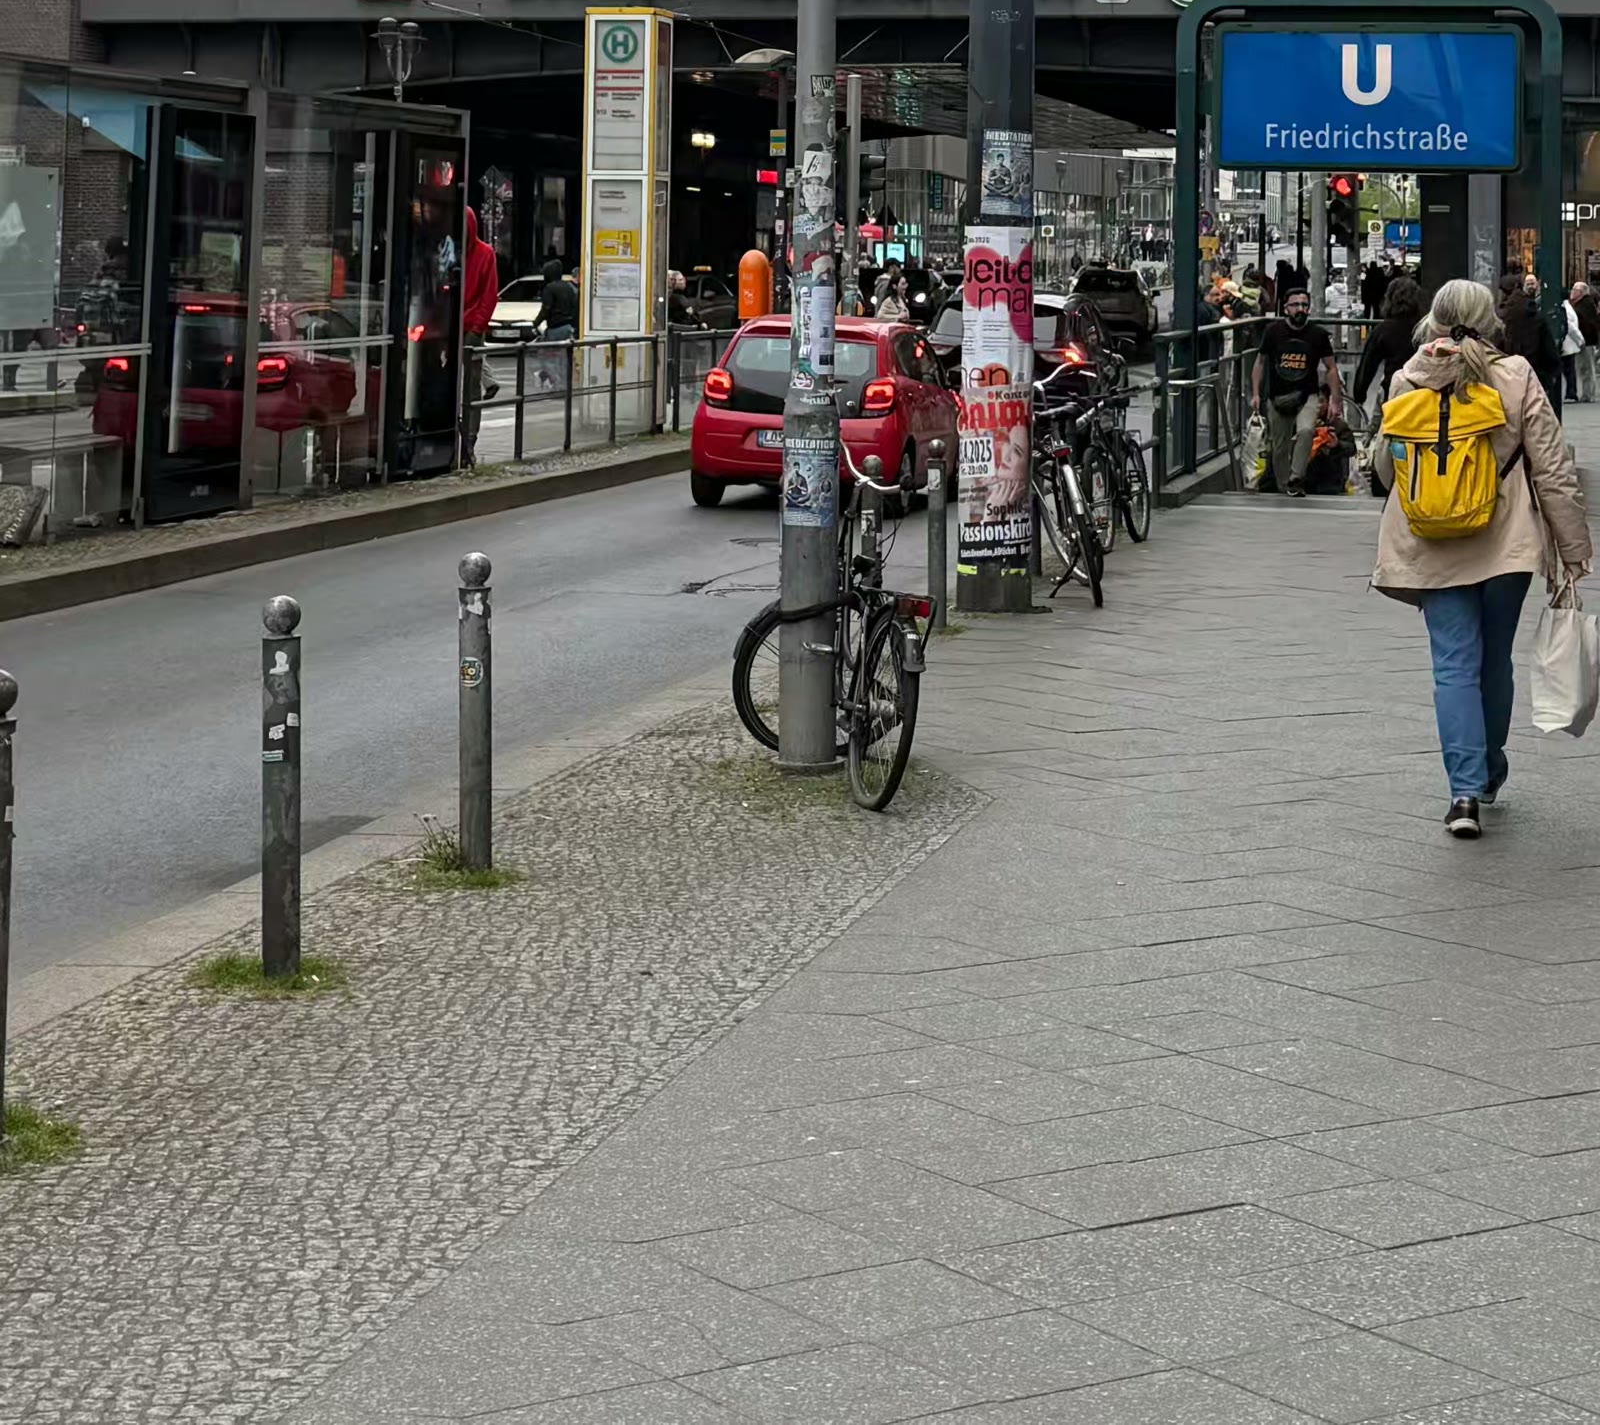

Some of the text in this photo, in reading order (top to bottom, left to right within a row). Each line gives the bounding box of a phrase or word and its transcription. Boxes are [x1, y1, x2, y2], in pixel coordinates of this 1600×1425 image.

[611, 34, 629, 55] H
[1341, 44, 1393, 106] U
[1265, 123, 1468, 152] Friedrichstraße
